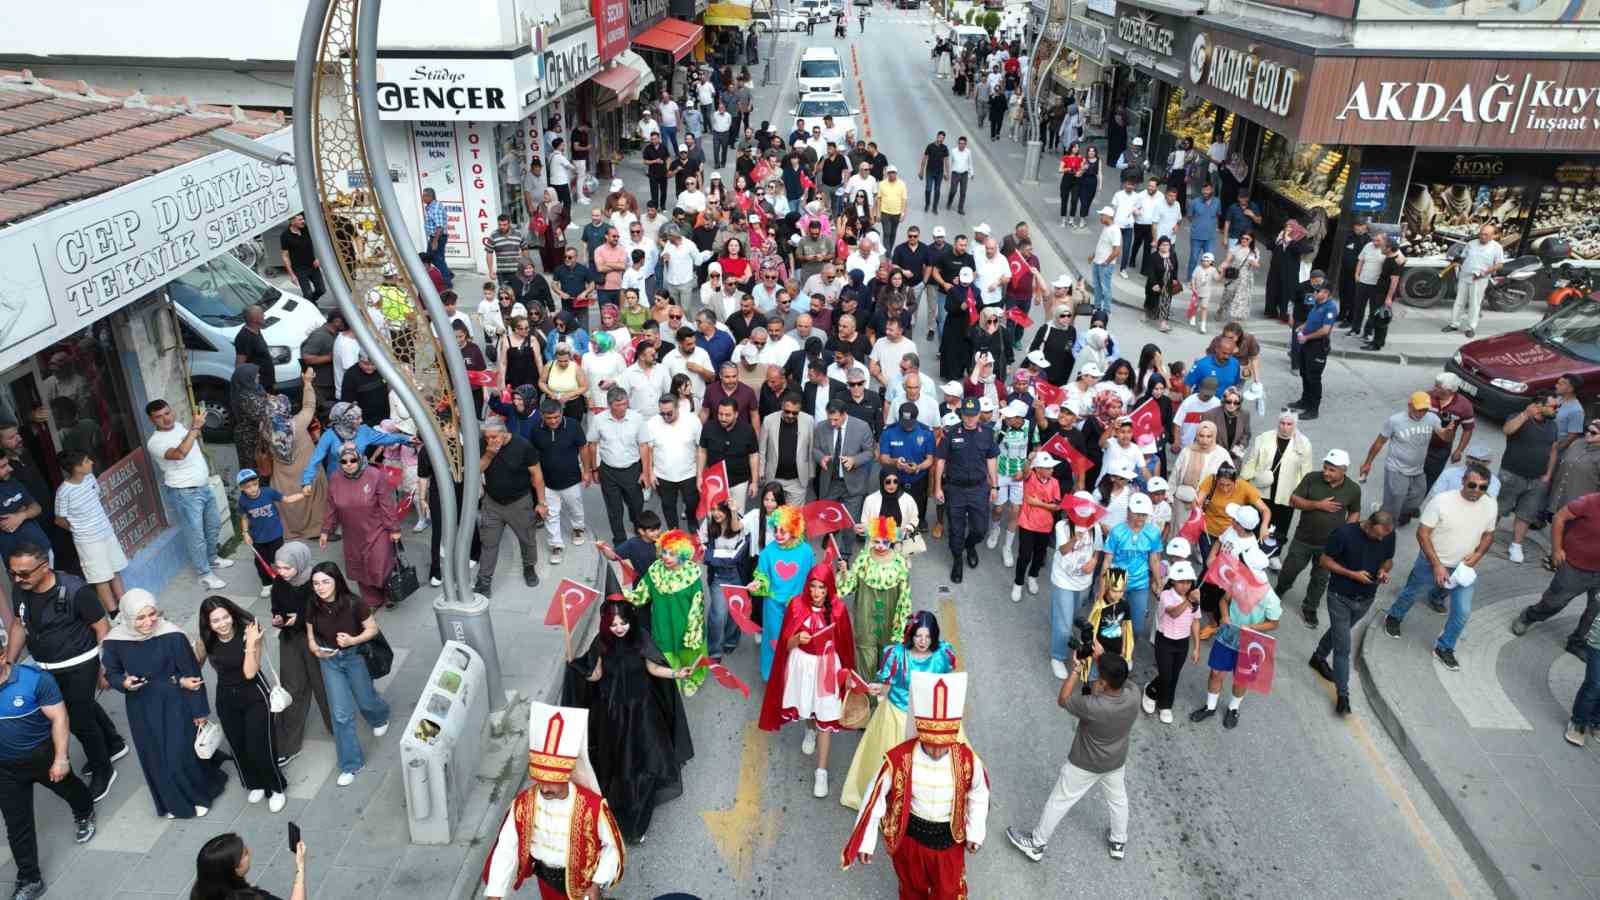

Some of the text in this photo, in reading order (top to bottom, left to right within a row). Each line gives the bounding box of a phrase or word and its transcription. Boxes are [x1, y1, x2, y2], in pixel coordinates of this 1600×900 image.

[377, 82, 506, 115] GENÇER
[409, 65, 465, 83] Stüdyo
[1253, 60, 1295, 117] GOLD
[1335, 74, 1516, 124] AKDAĞ
[1526, 109, 1587, 132] İnşaat
[152, 160, 286, 234] DÜNYASI
[207, 187, 289, 250] SERVİS
[56, 209, 141, 275] CEP
[67, 232, 201, 317] TEKNİK
